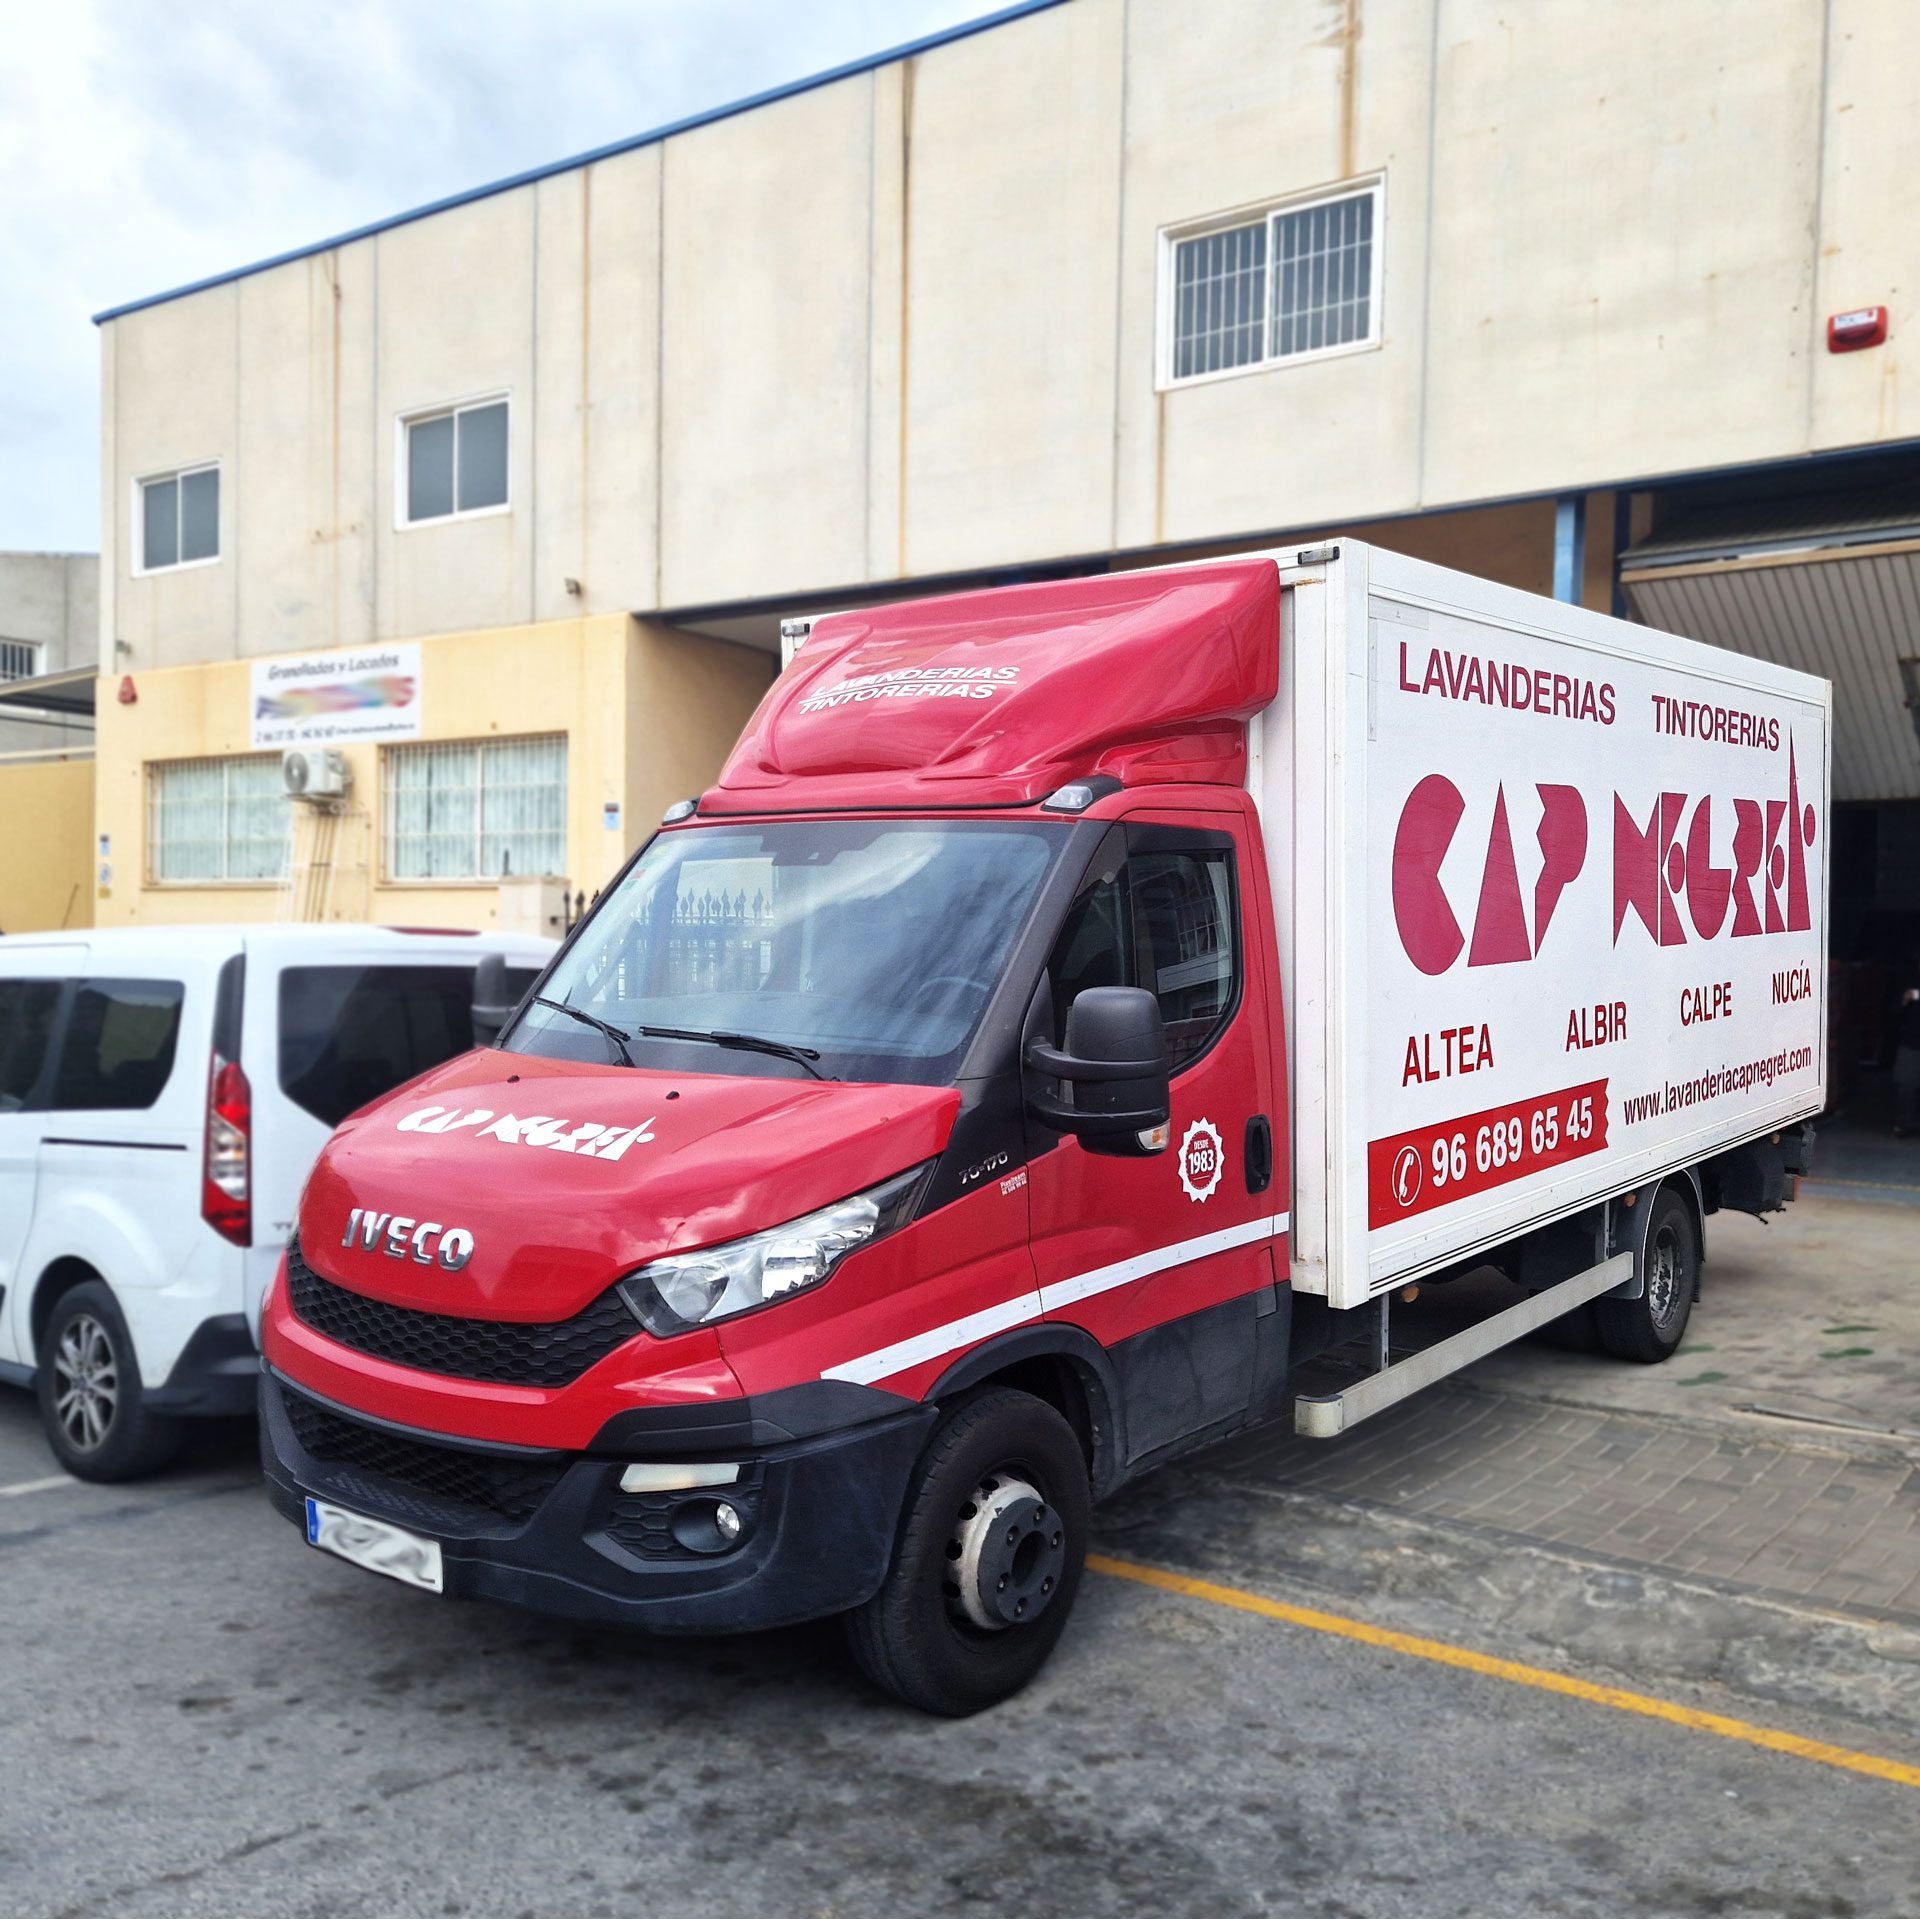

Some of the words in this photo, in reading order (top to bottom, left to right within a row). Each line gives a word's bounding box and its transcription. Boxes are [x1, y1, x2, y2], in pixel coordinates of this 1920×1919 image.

[799, 683, 998, 715] TINTORERIAS
[811, 666, 1020, 698] LAVANDERIAS
[1399, 641, 1616, 726] LAVANDERIAS
[1651, 695, 1781, 752] TINTORERIAS
[1392, 773, 1588, 976] CAP
[1613, 722, 1816, 950] NEGRET
[1402, 1023, 1494, 1088] ALTEA
[1565, 1001, 1627, 1053] ALBIR
[1680, 981, 1732, 1027] CALPE
[1772, 959, 1812, 1006] NUCÍA
[1623, 1046, 1812, 1126] www.lavanderiacapnegret.com
[396, 1106, 495, 1134] CAP
[1194, 1139, 1209, 1150] DESDE
[1431, 1137, 1467, 1188] 96
[1475, 1117, 1523, 1173] 689
[1530, 1106, 1559, 1155] 65
[1566, 1096, 1593, 1142] 45
[1188, 1149, 1214, 1175] 1983
[341, 1208, 475, 1272] IVECO
